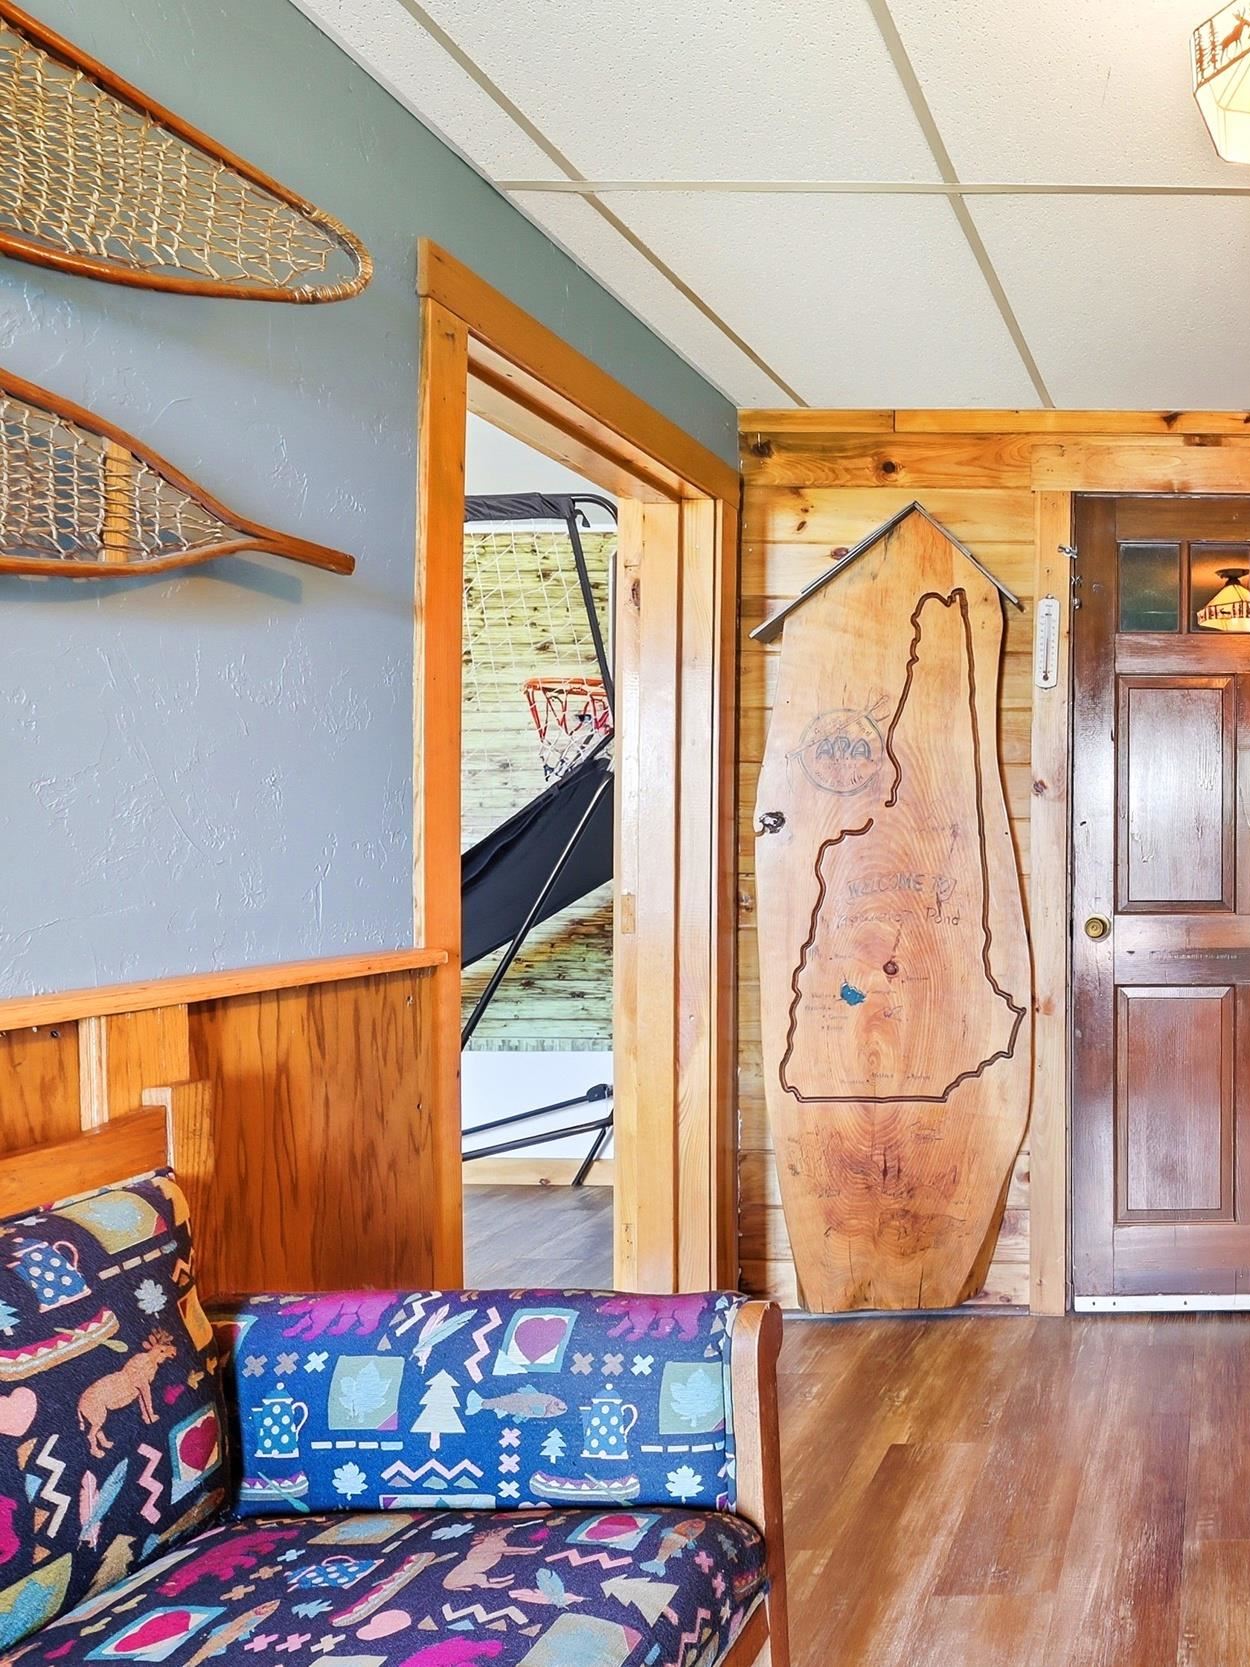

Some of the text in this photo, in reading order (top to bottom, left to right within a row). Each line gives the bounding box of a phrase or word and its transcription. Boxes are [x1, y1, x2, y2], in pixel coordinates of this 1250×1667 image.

[815, 735, 872, 760] APA
[847, 872, 925, 897] WELCOME
[926, 907, 961, 926] Pond
